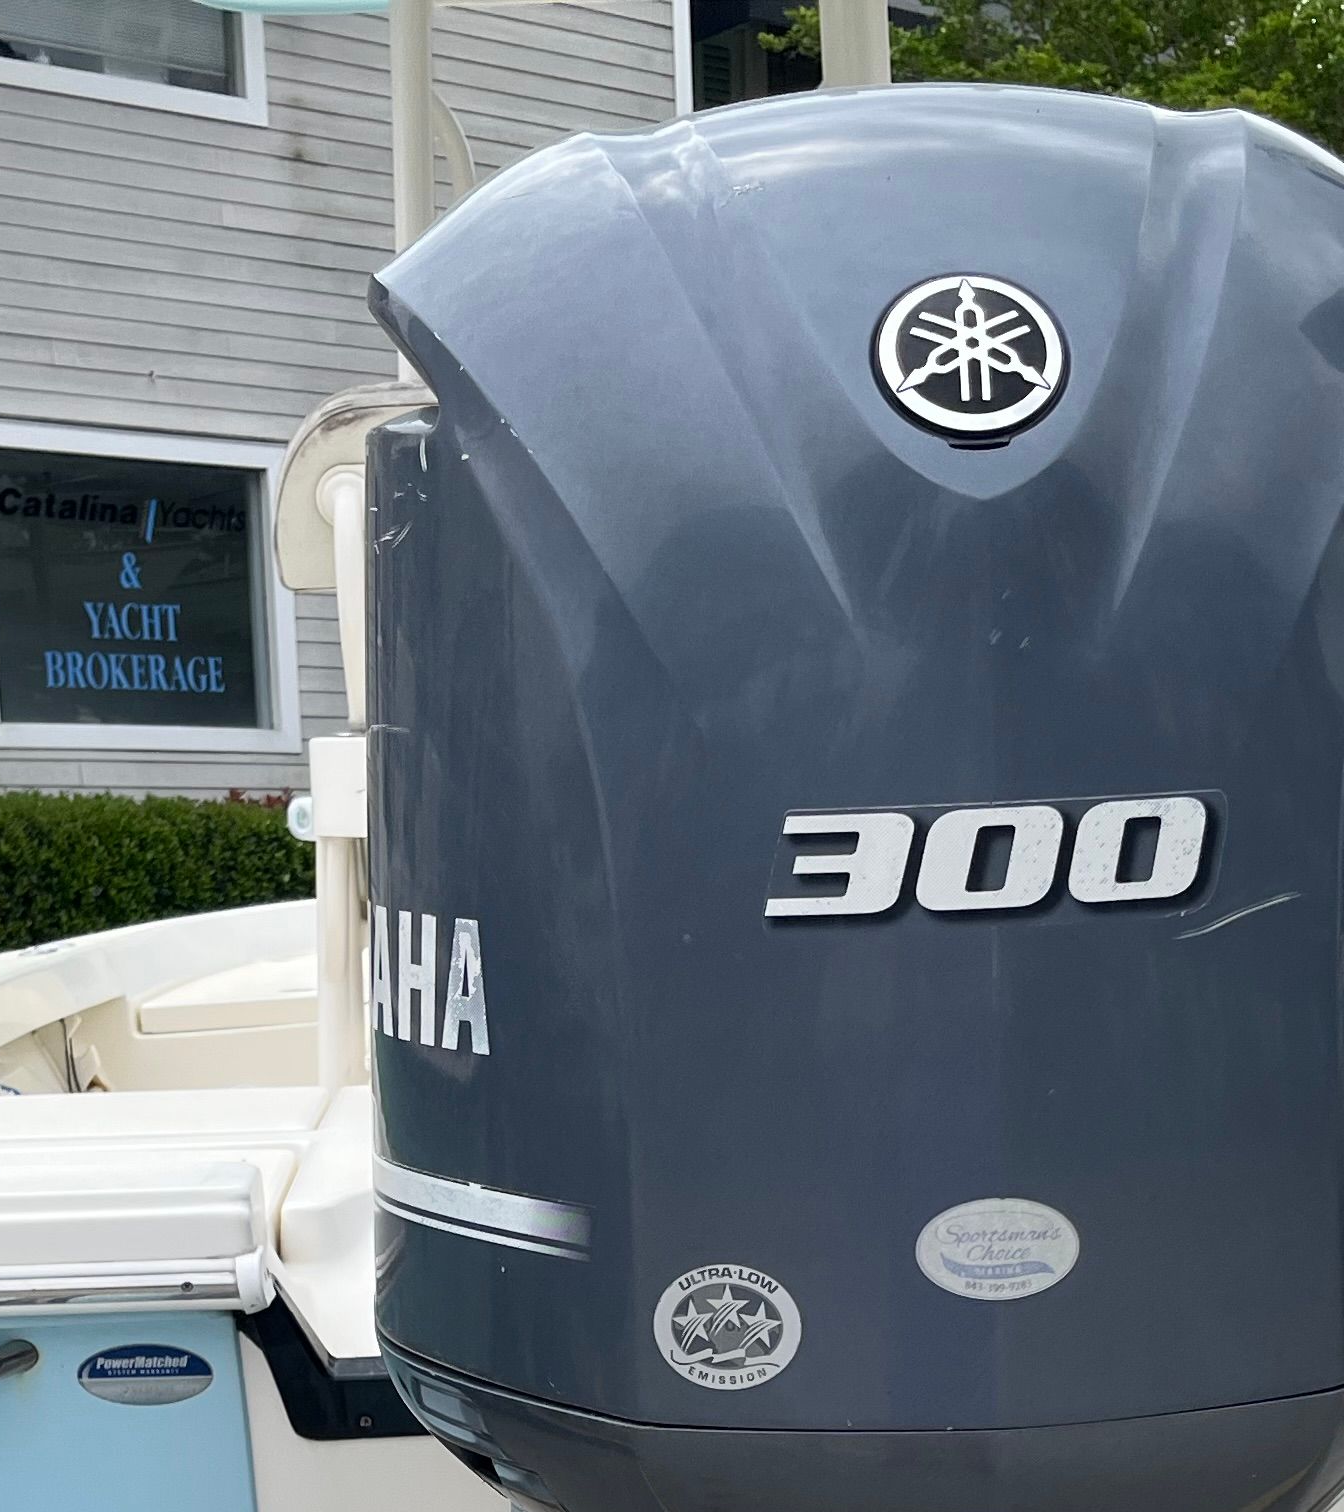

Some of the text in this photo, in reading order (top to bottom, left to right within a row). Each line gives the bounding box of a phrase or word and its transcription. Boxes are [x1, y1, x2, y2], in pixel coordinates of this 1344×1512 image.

[156, 502, 246, 532] Yachts
[119, 552, 142, 589] &
[83, 601, 181, 642] YACHT
[44, 650, 226, 693] BROKERAGE
[763, 796, 1207, 918] 300
[965, 1244, 1031, 1261] Choice
[96, 1354, 189, 1370] PowerMatched
[687, 1365, 768, 1386] EMISSION
